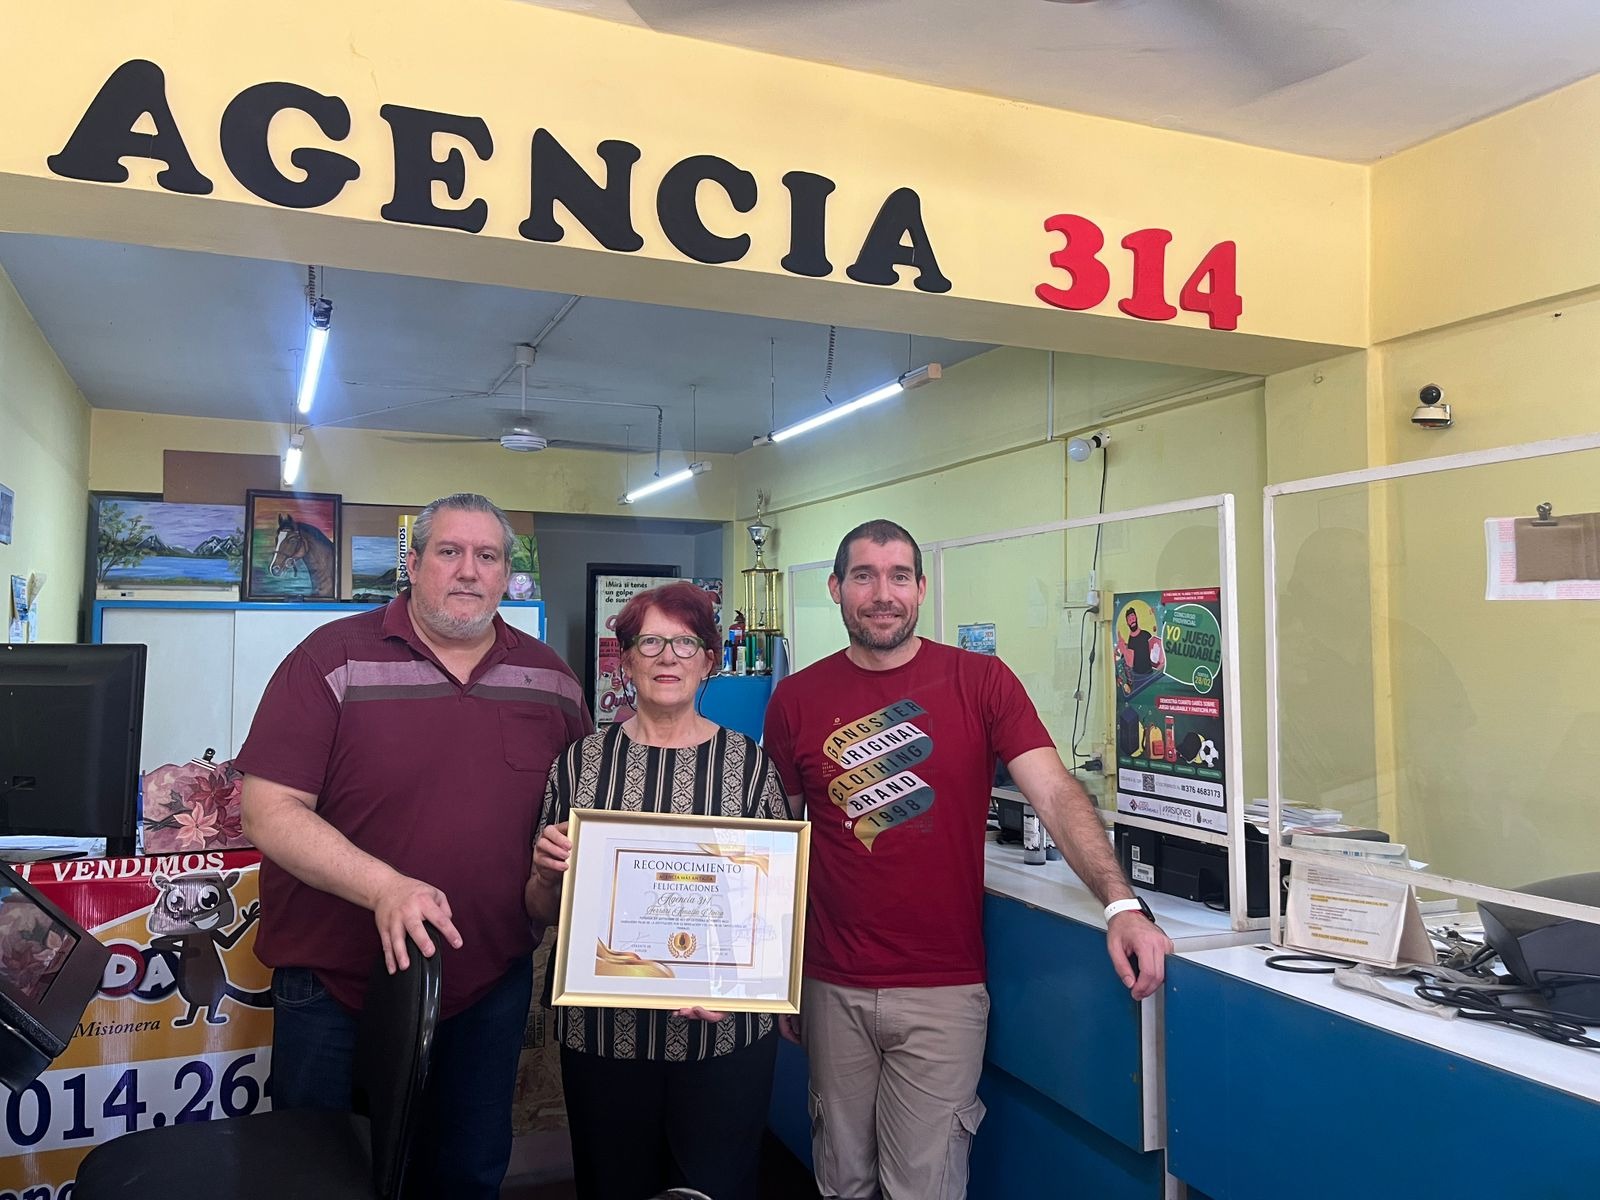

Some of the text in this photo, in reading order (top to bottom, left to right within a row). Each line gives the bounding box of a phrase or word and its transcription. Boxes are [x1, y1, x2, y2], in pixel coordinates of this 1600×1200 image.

[46, 58, 1243, 331] AGENCIA 314
[399, 528, 407, 579] obramos
[615, 589, 633, 597] golpe
[1166, 625, 1216, 648] YO JUEGO
[1164, 640, 1221, 663] SALUDABLE
[827, 701, 921, 760] GANGSTER
[831, 744, 923, 801] CLOTHING
[849, 775, 917, 812] BRAND
[1185, 784, 1196, 794] 376
[867, 799, 921, 828] 1998
[52, 851, 224, 882] VENDIMOS
[633, 859, 742, 874] RECONOCIMIENTO
[653, 882, 720, 893] FELICITACIONES
[73, 1018, 161, 1039] Misionera
